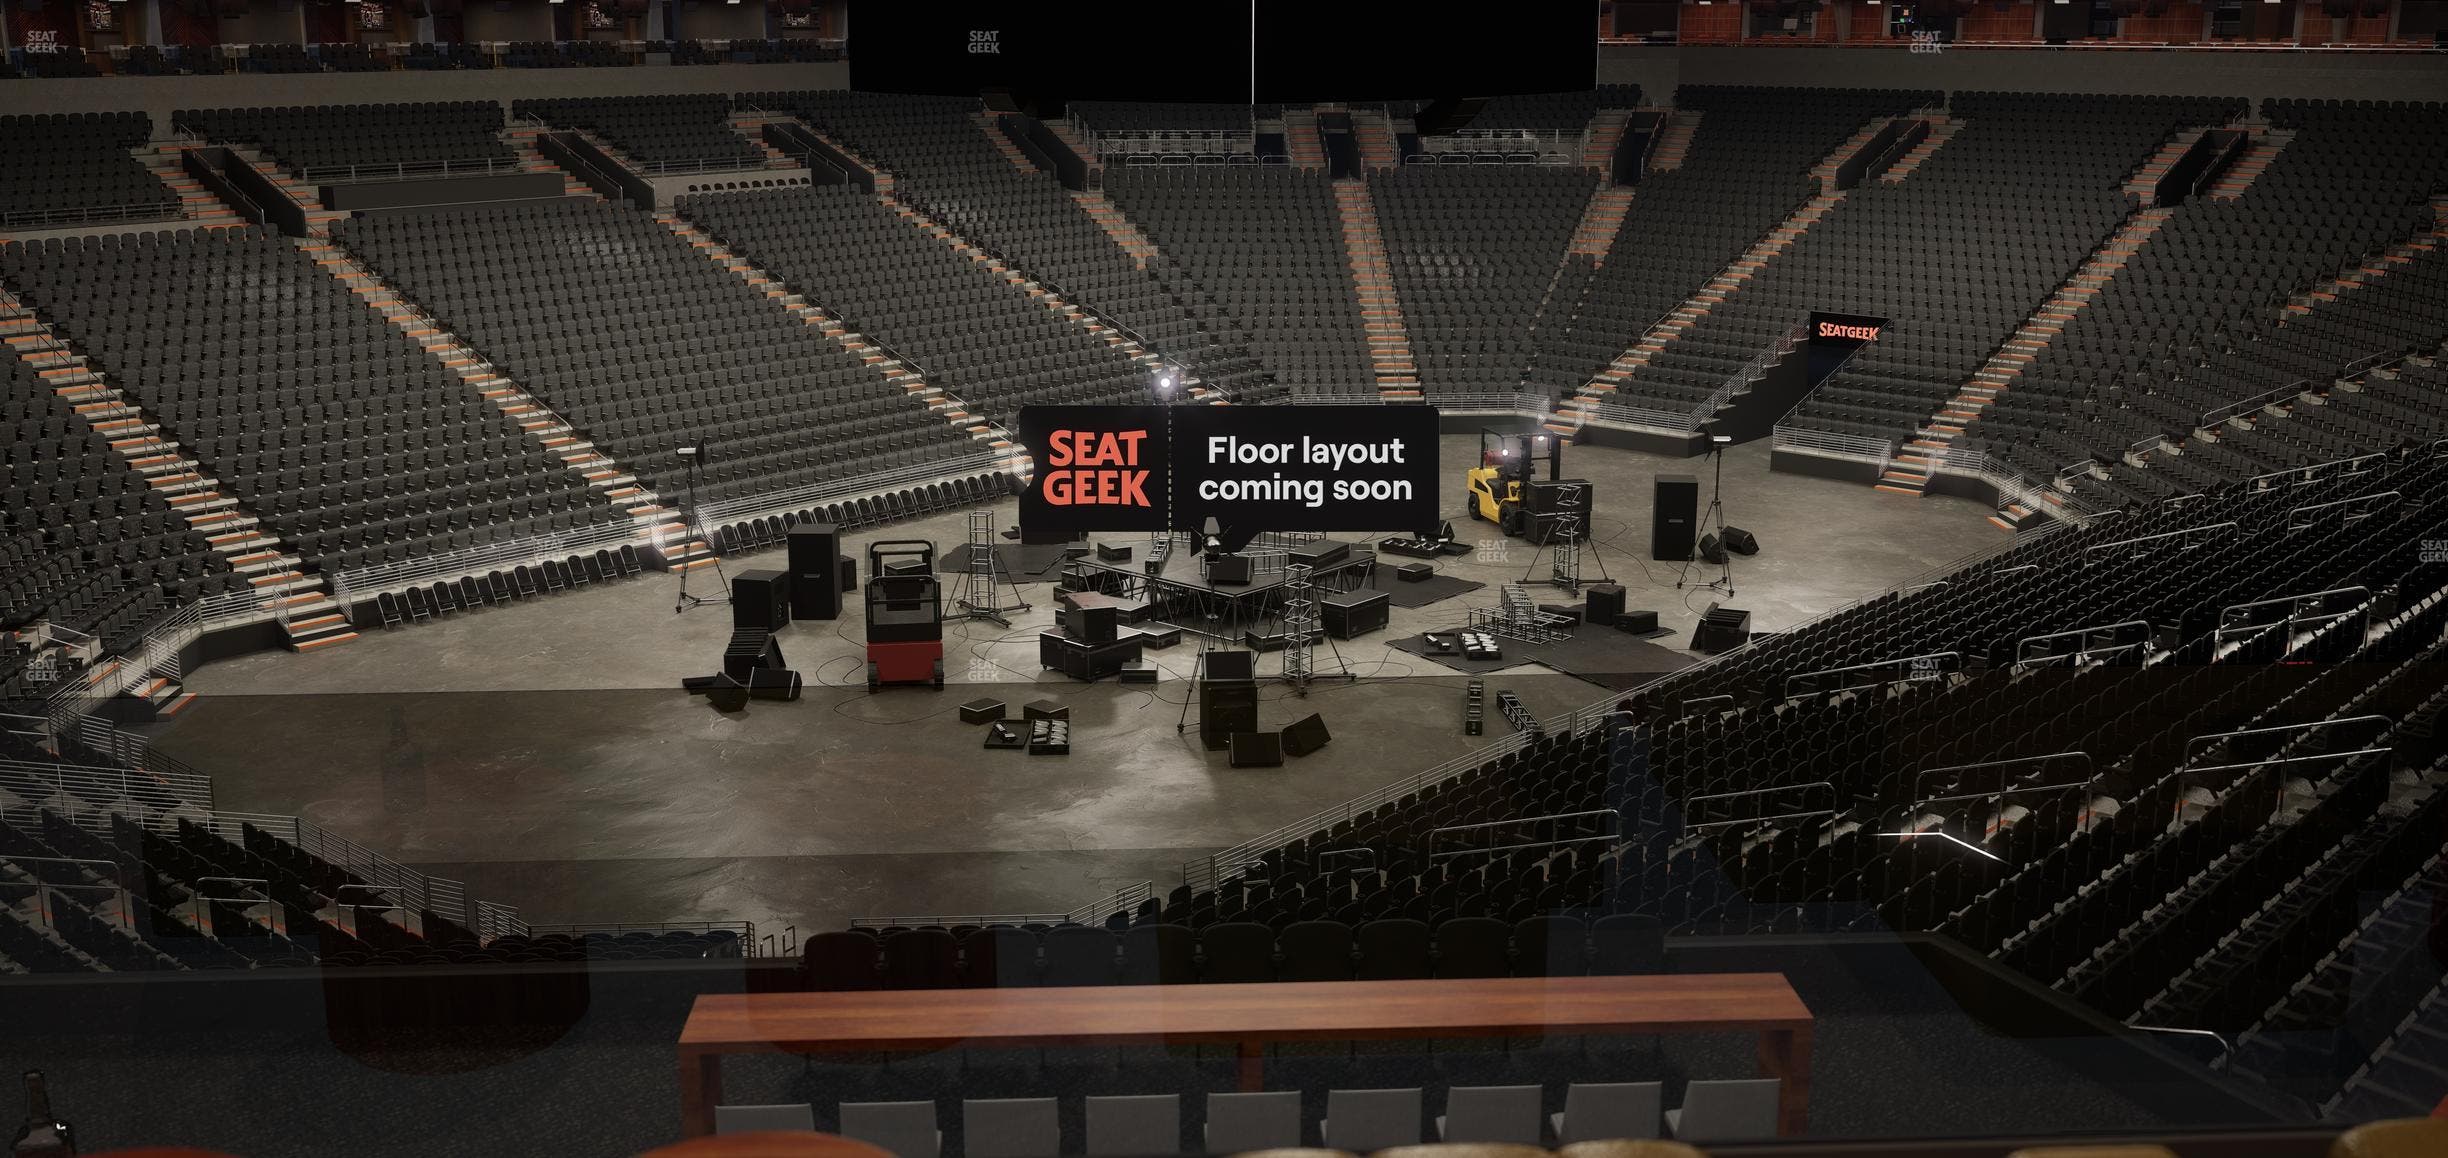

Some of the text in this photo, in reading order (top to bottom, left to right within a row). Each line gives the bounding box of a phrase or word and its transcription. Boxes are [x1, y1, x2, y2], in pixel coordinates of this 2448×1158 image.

[1819, 322, 1880, 341] SEATGEEK
[1050, 430, 1147, 466] SEAT
[1209, 436, 1404, 470] Floor layout
[1043, 470, 1151, 506] GEEK
[1199, 473, 1411, 507] coming soon
